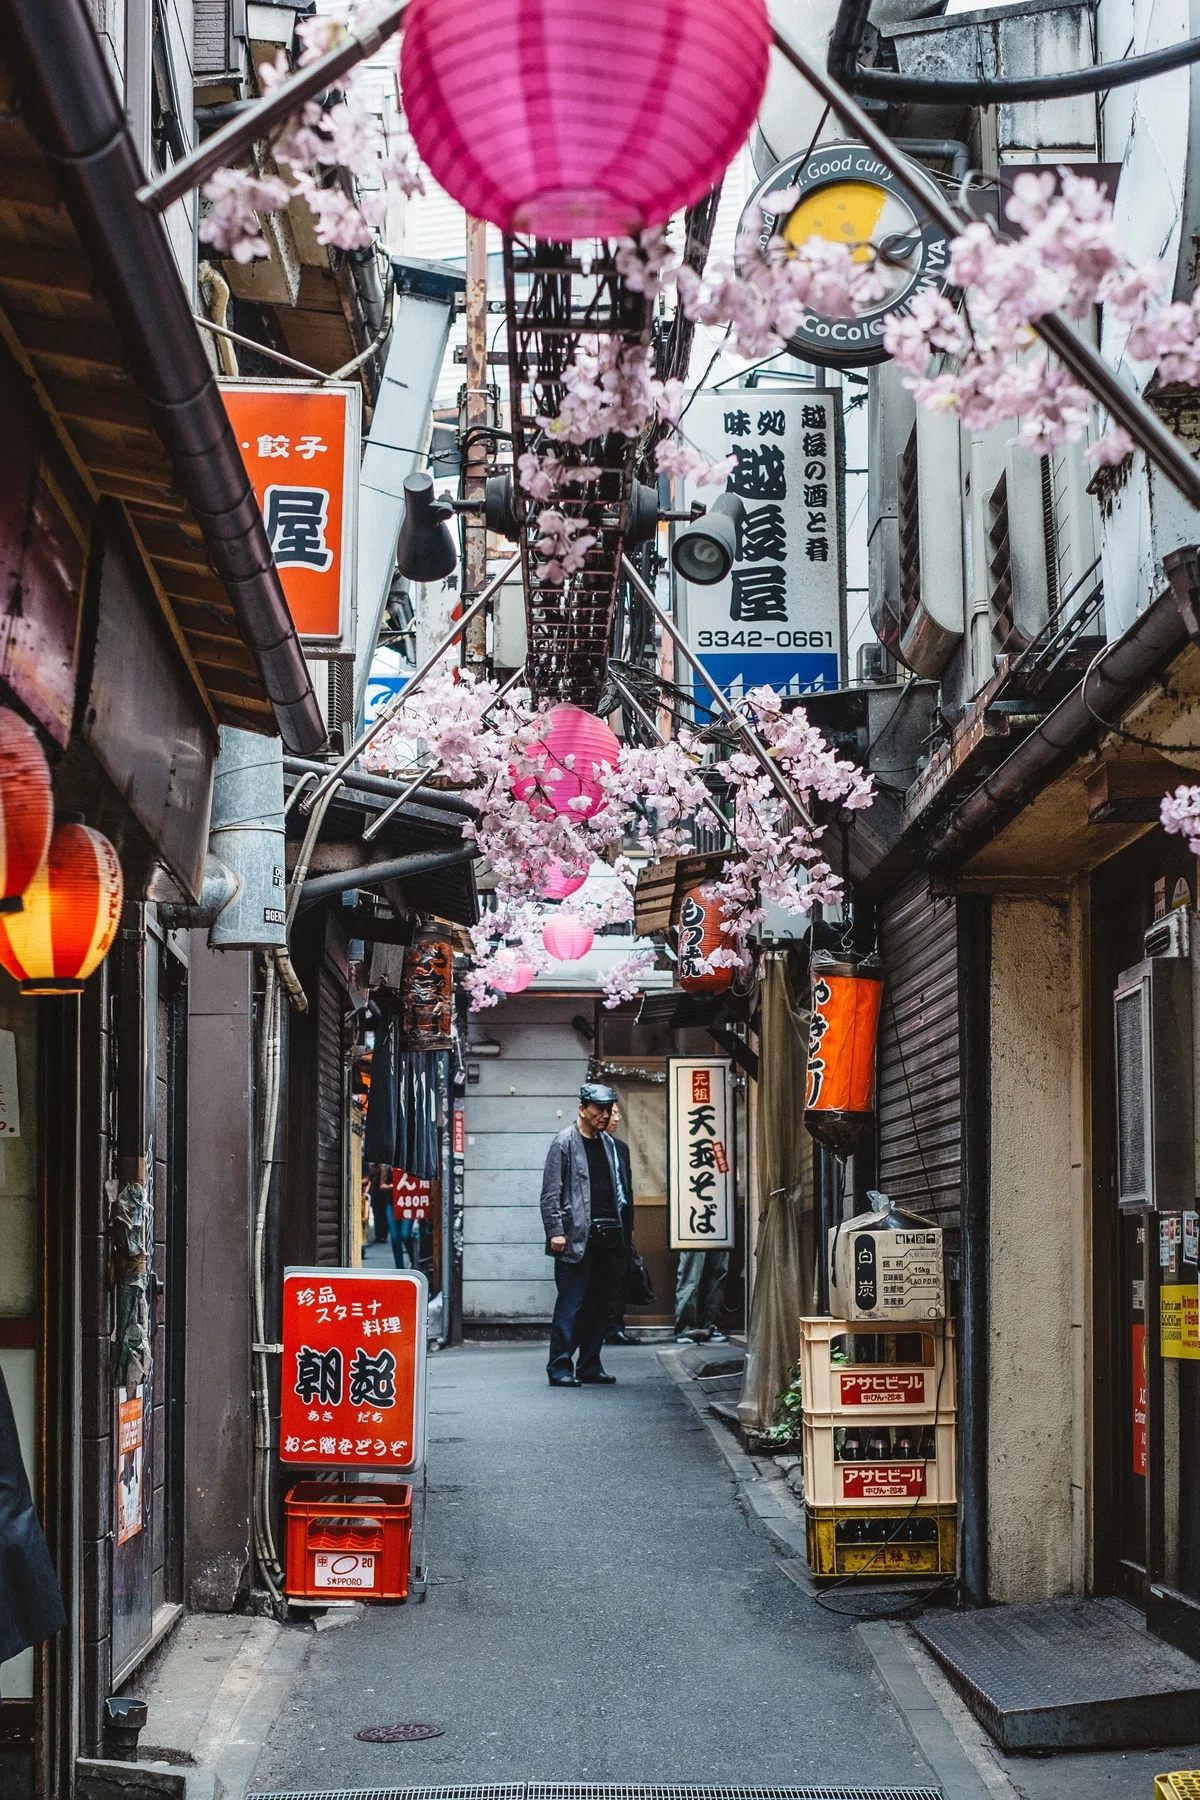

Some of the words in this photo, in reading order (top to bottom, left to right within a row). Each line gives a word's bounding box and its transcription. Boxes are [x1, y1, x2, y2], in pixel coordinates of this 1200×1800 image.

[807, 154, 852, 179] Good
[855, 158, 895, 182] curry
[758, 210, 775, 250] ood
[723, 409, 785, 436] 味処
[264, 485, 333, 573] 屋
[725, 444, 788, 623] 越後屋
[698, 631, 833, 648] 3342-0661
[694, 1074, 709, 1101] 元祖
[688, 1105, 717, 1234] 天玉そば
[397, 1195, 429, 1207] 480円
[858, 1248, 874, 1298] 白炭
[296, 1286, 336, 1306] 珍品
[316, 1300, 382, 1324] スタミナ
[362, 1316, 402, 1337] 料理
[294, 1345, 396, 1408] 朝起
[842, 1376, 923, 1391] アサヒビール
[308, 1410, 334, 1423] あさ
[357, 1411, 383, 1423] だち
[284, 1435, 408, 1457] お二階をどうぞ
[844, 1469, 923, 1483] アサヒビール
[362, 1558, 373, 1568] 20
